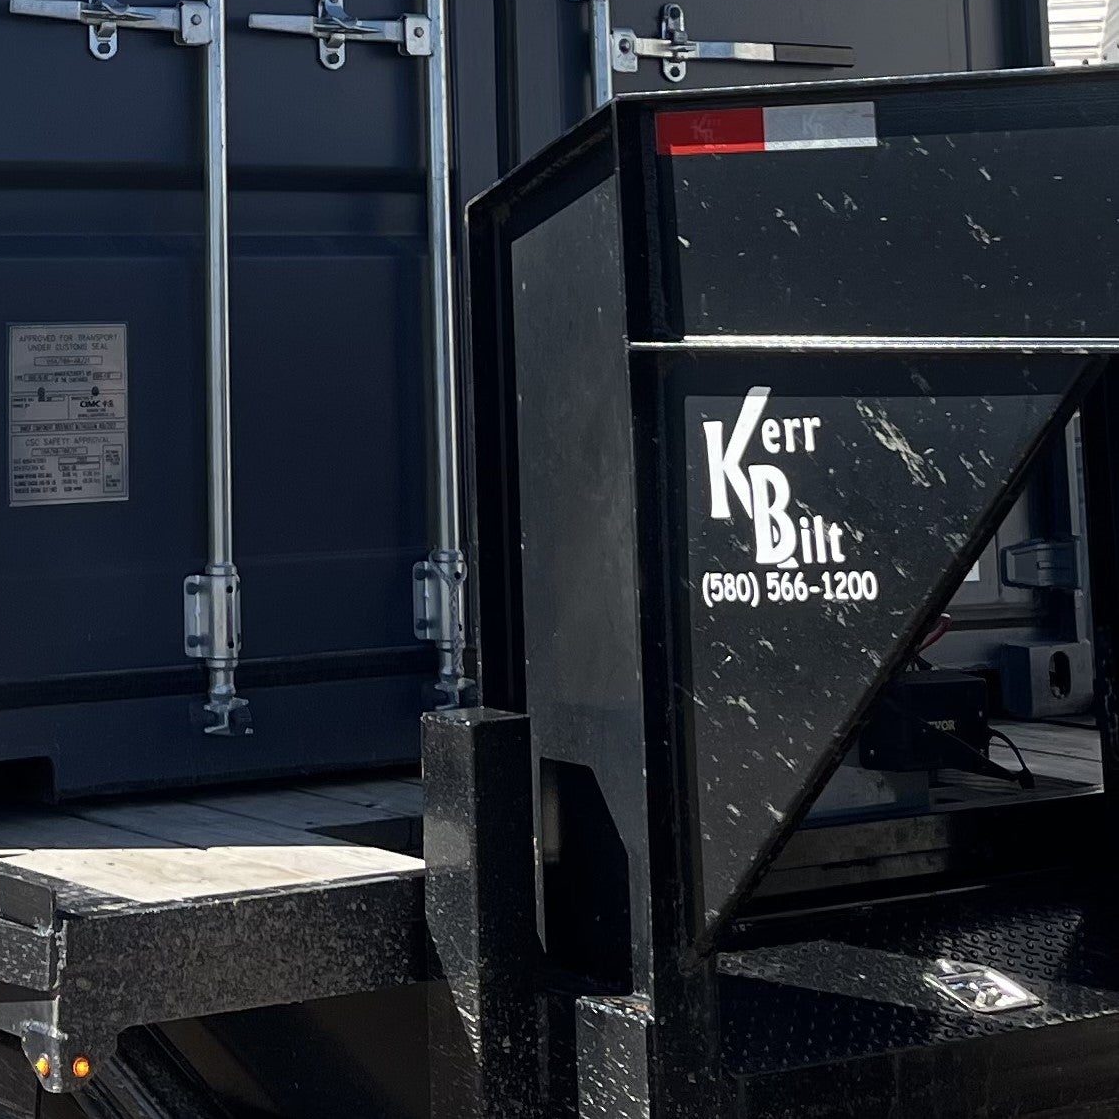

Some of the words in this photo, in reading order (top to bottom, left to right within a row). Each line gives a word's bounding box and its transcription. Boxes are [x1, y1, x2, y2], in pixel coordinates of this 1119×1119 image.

[19, 334, 56, 343] APPROVED
[77, 333, 118, 342] TRANSPORT
[28, 343, 52, 352] UNDER
[56, 342, 87, 351] CUSTOMS
[92, 342, 108, 350] SEAL
[703, 386, 822, 519] Kerr
[748, 464, 846, 568] Bilt
[702, 571, 761, 608] (580)
[765, 570, 879, 602] 566-1200
